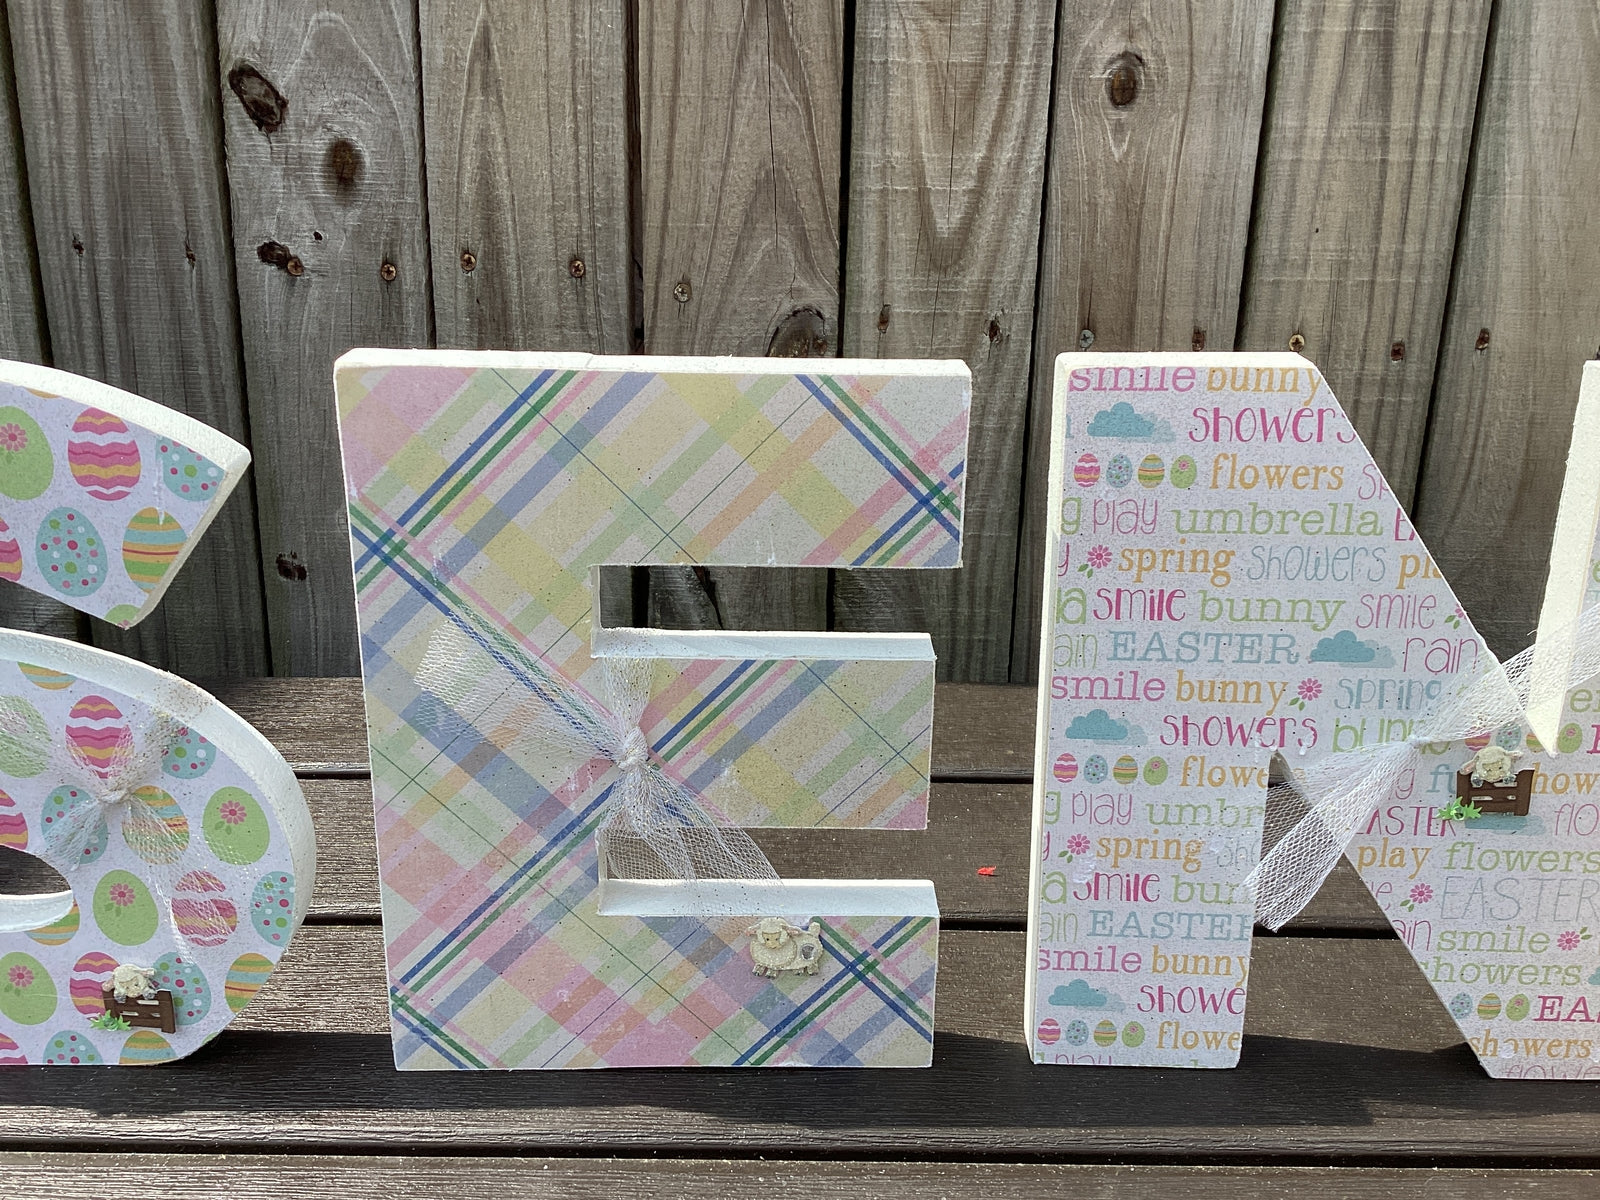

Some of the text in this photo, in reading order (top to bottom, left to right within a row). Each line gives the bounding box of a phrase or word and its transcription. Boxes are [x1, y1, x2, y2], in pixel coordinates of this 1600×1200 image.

[1206, 367, 1323, 406] bunny
[1209, 453, 1344, 490] flowers
[1093, 499, 1158, 534] play
[1170, 502, 1383, 536] umbrella
[1118, 538, 1235, 588] spring
[1247, 545, 1386, 582] showers
[1093, 588, 1186, 621] smile
[1198, 590, 1346, 632] bunny
[1356, 594, 1437, 629] smile
[1106, 630, 1299, 664] EASTER
[1403, 638, 1478, 675] rain
[1051, 670, 1166, 702] smile
[1175, 669, 1289, 716] bunny
[1159, 715, 1318, 748] showers
[1072, 793, 1132, 825] play
[1096, 829, 1205, 873] spring
[1357, 837, 1432, 880] play
[1443, 841, 1600, 873] flowers
[1440, 876, 1600, 922] EASTER
[1437, 925, 1550, 954] smile
[1038, 945, 1583, 986] smile bunny howers
